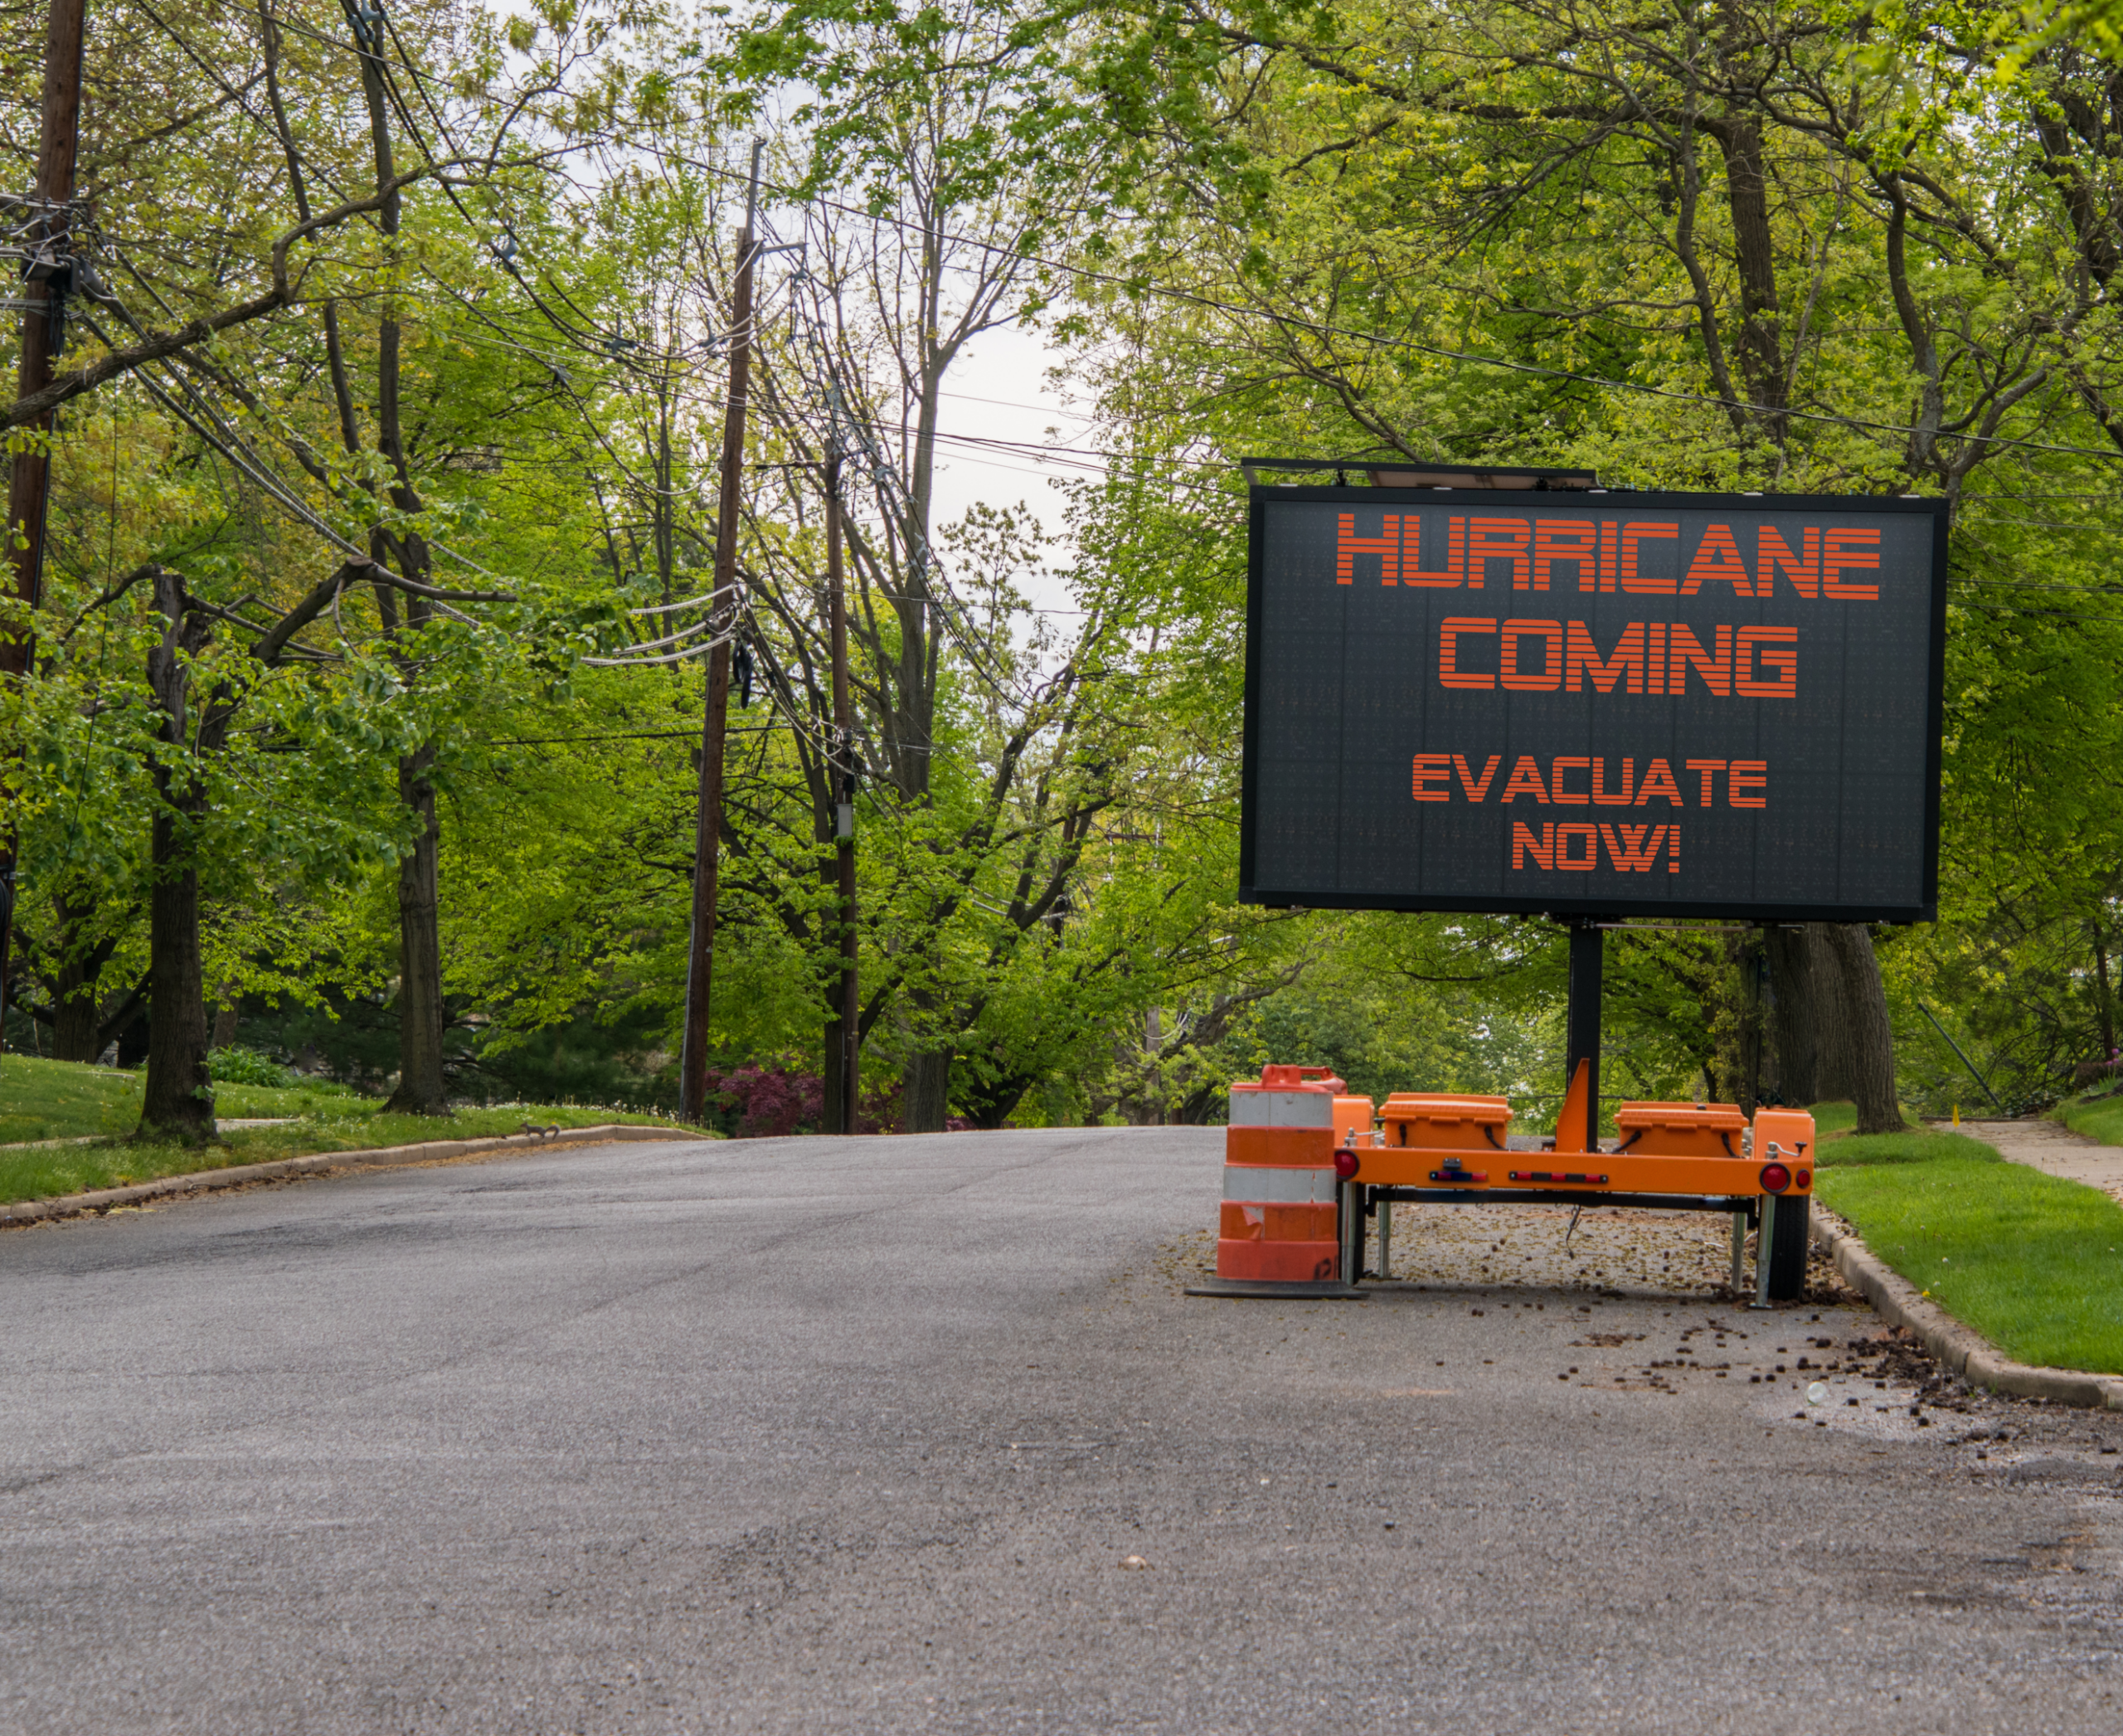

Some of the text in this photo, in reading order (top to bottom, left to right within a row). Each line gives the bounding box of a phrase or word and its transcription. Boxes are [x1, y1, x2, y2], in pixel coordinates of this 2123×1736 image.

[1337, 513, 1880, 601] HURRICANE
[1439, 616, 1798, 698] COMING
[1412, 753, 1767, 809] EVACUATE
[1512, 821, 1681, 873] NOW!
